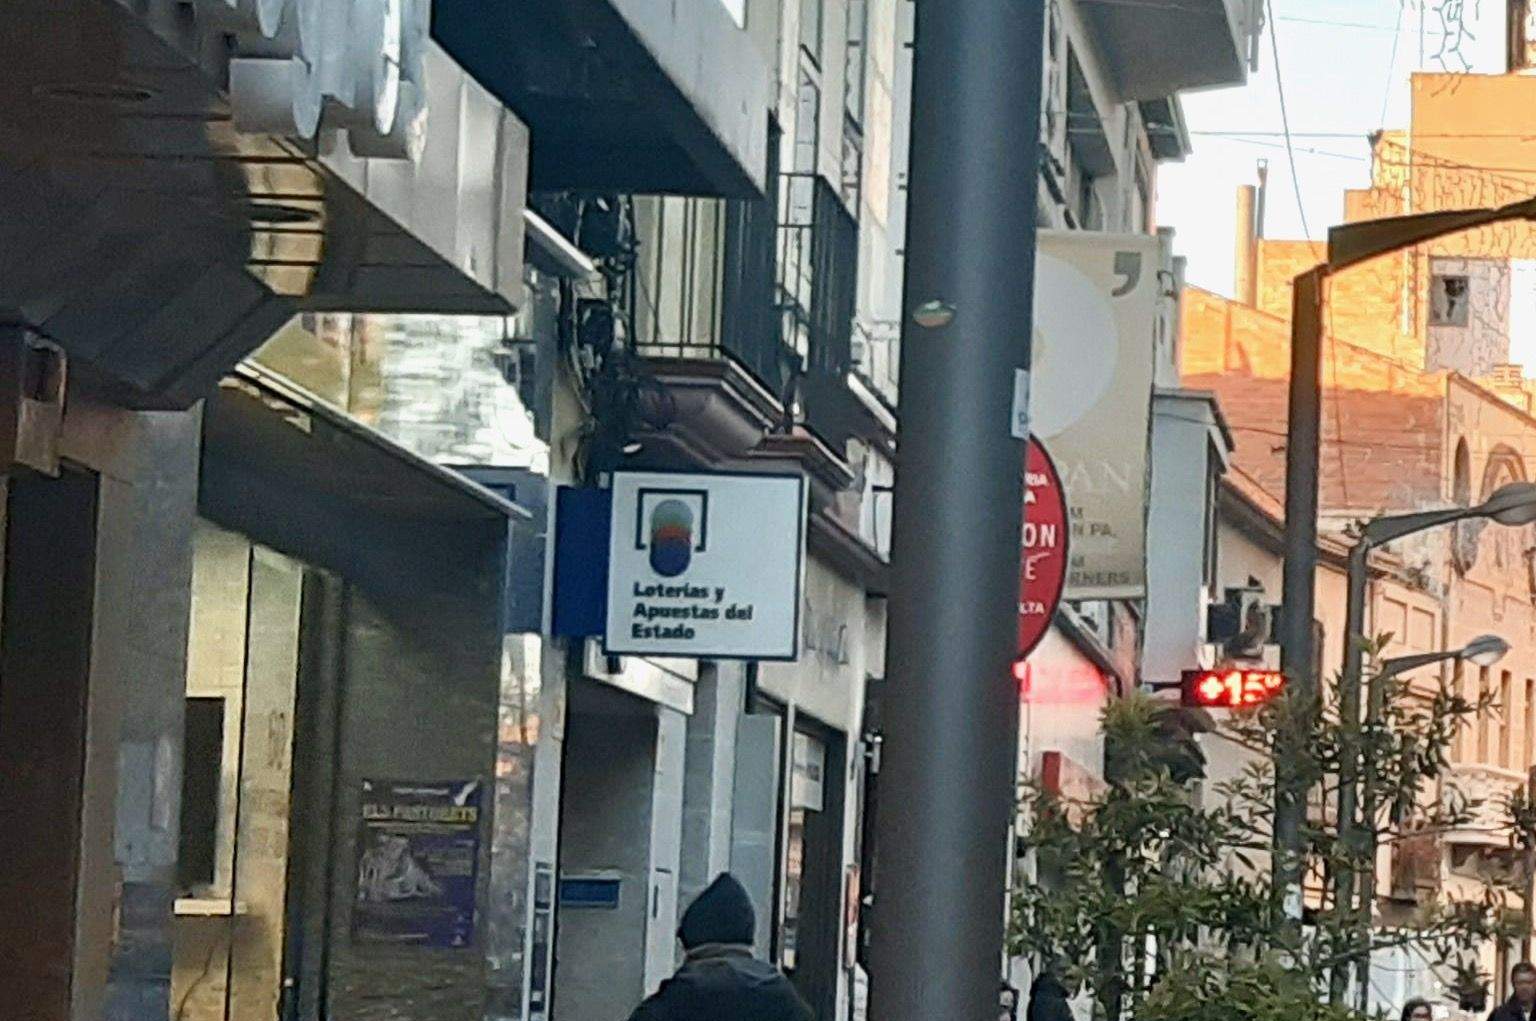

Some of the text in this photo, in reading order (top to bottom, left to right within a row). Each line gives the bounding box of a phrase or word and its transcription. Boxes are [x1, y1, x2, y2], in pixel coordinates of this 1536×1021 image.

[1023, 522, 1056, 548] ON
[714, 587, 725, 604] y
[633, 602, 754, 621] Apuestas del
[631, 623, 696, 640] Estado
